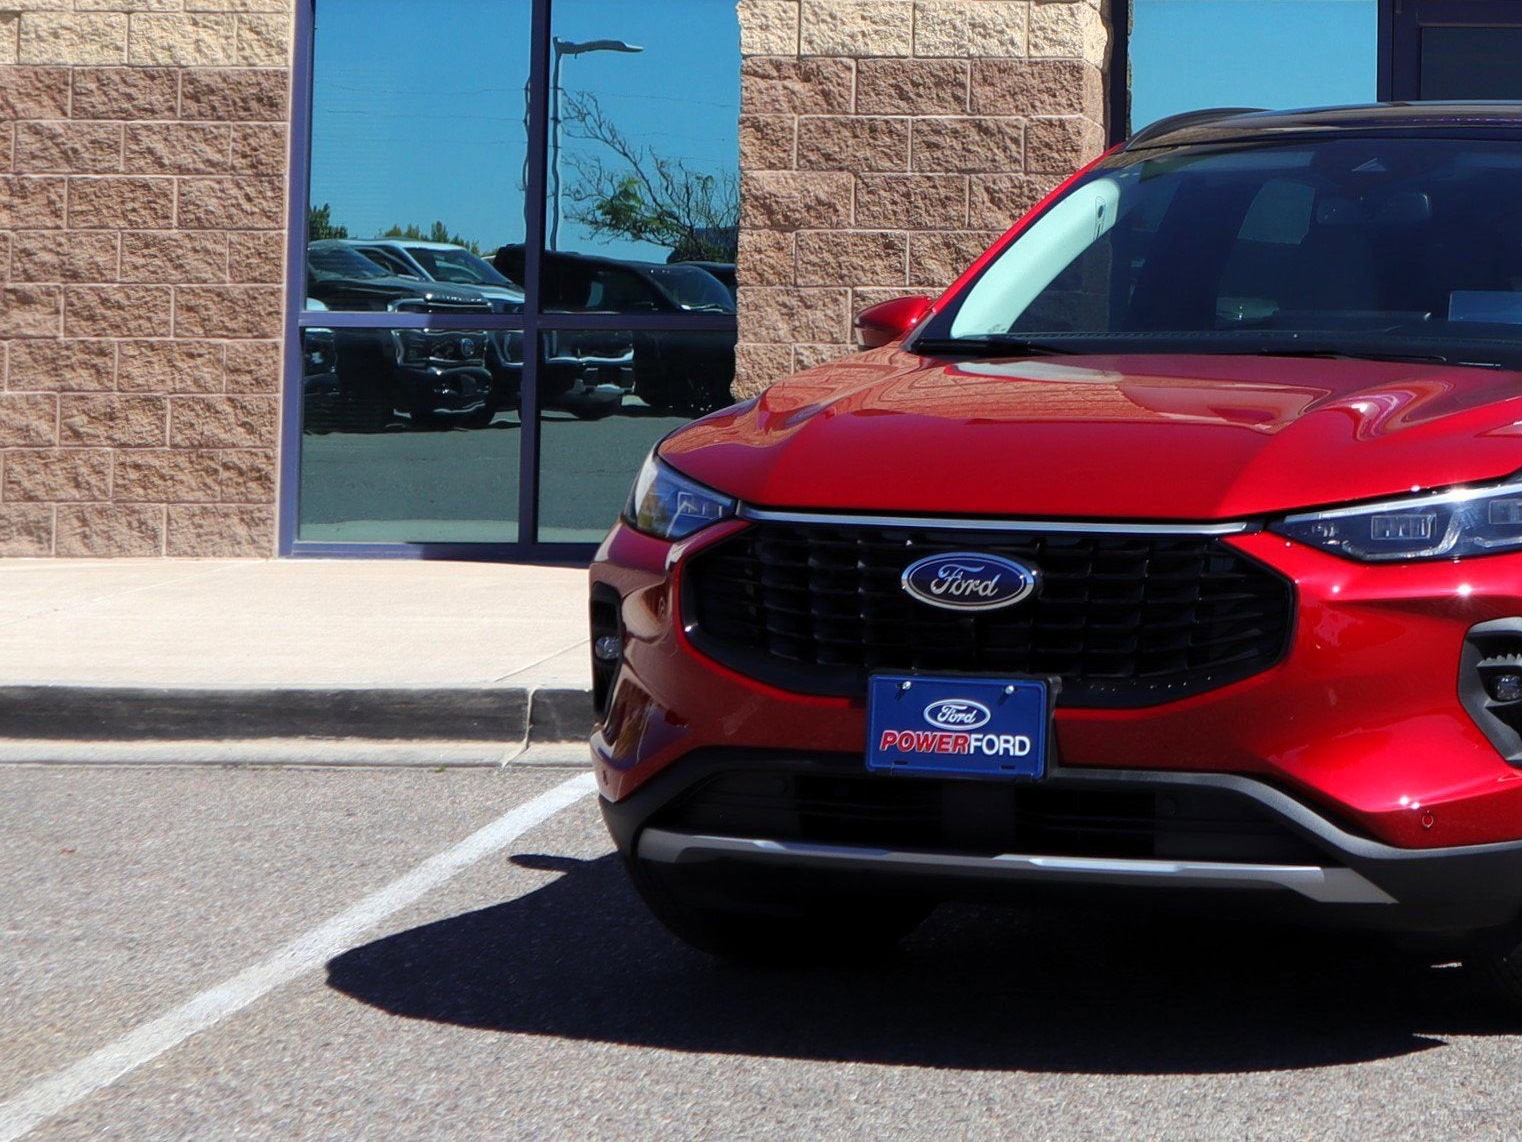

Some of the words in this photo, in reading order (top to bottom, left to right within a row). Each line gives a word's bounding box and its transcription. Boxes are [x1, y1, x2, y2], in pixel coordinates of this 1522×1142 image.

[930, 563, 1001, 597] Ford
[936, 704, 977, 724] Ford
[879, 730, 1031, 757] POWERFORD
